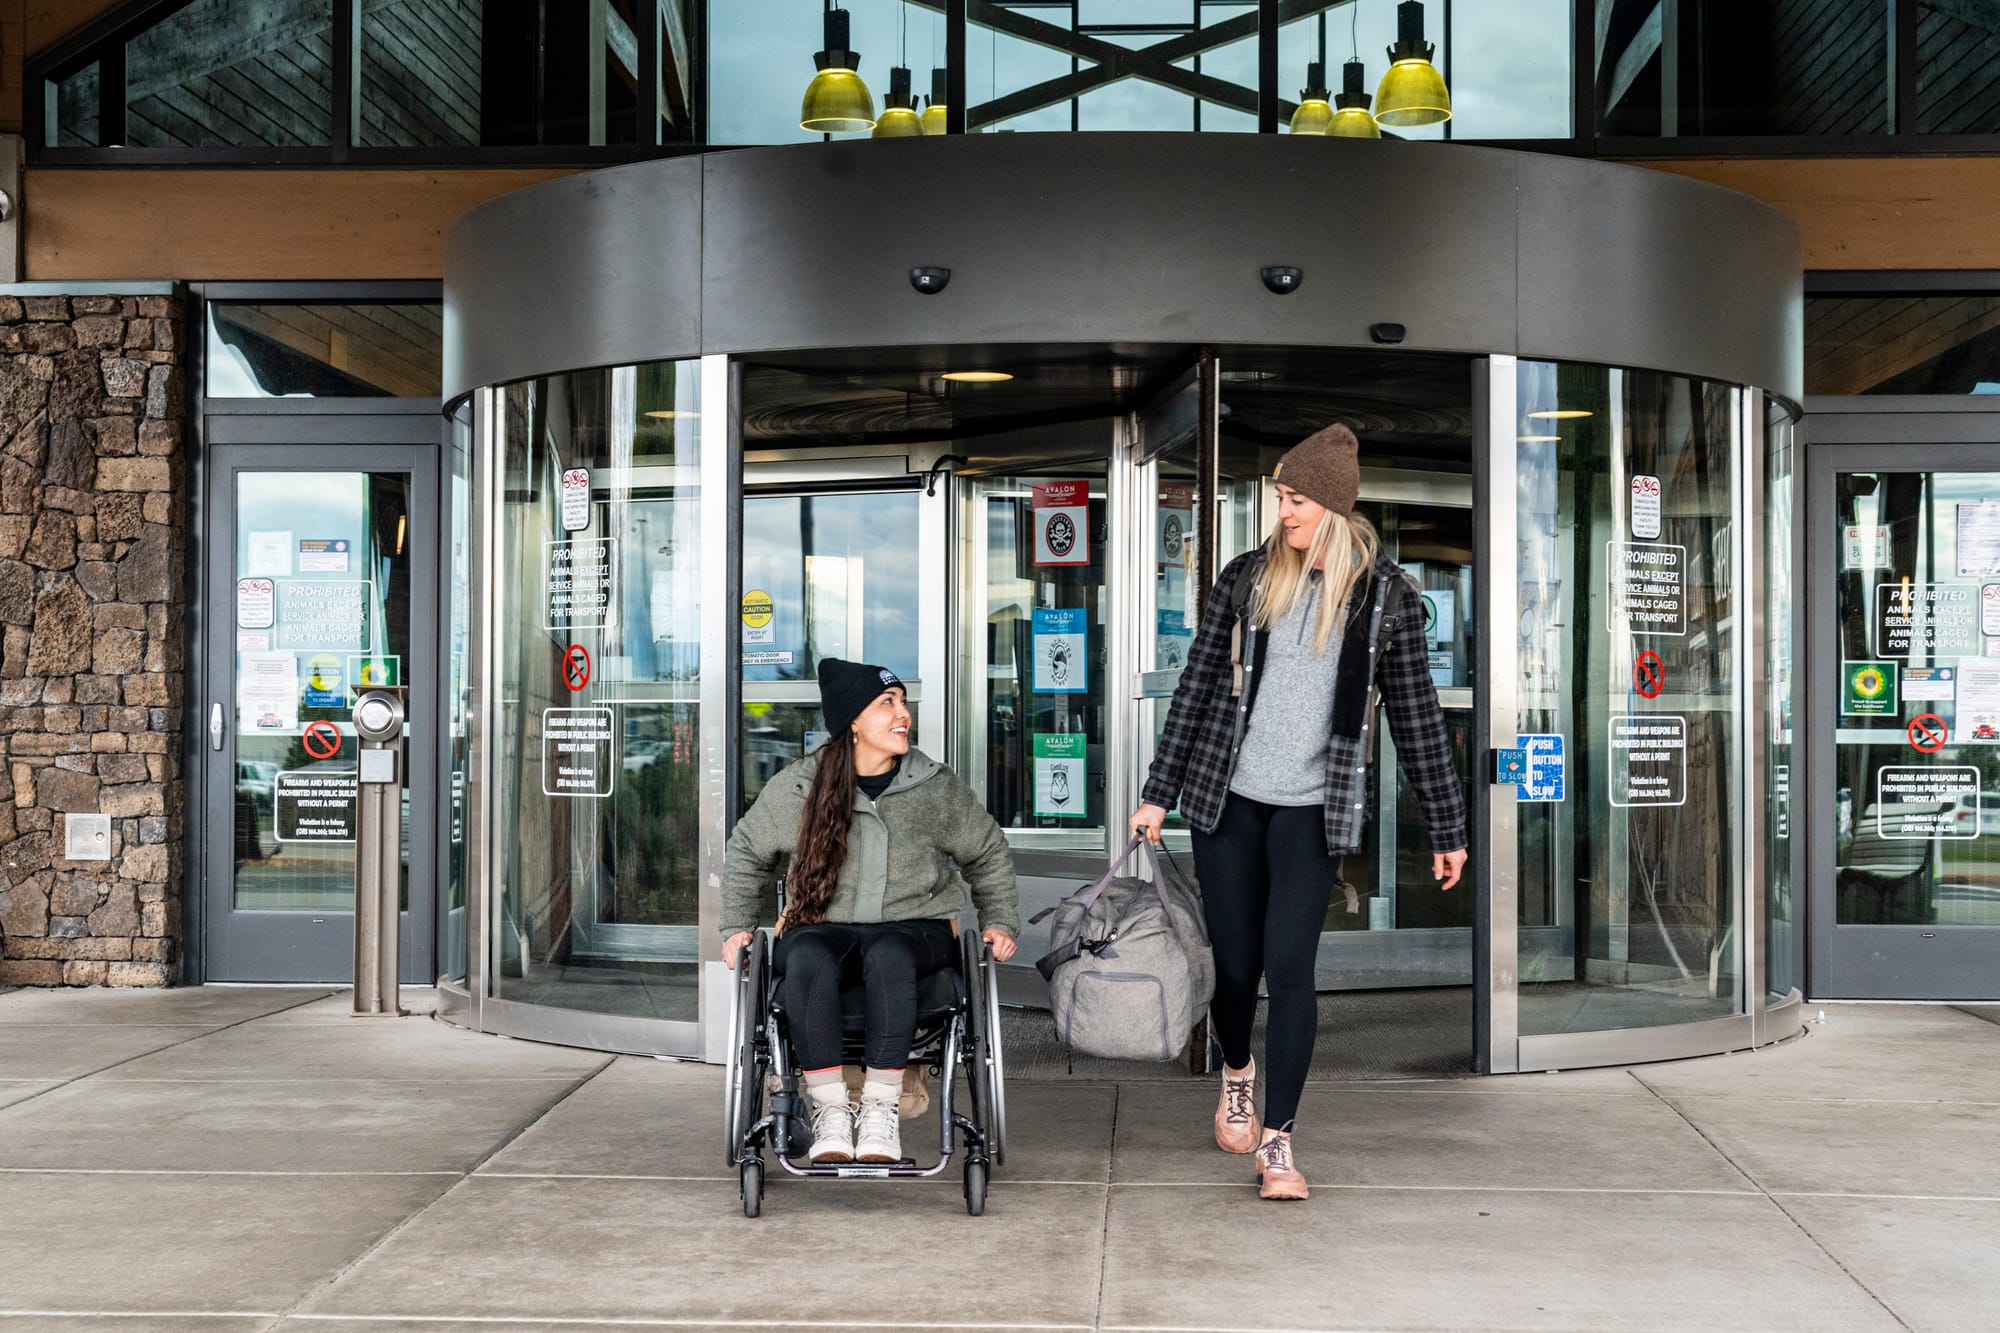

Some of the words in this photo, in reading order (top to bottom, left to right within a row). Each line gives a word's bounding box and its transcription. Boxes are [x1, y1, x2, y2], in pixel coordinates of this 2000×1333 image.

[552, 546, 606, 561] PROHIBITED
[1620, 550, 1676, 566] PROHIBITED
[550, 566, 580, 576] ANIMALS
[580, 564, 608, 575] EXCEPT
[1618, 569, 1650, 580] NIMALS
[1652, 571, 1679, 582] EXCEPT
[549, 580, 572, 590] SERVICE
[600, 578, 610, 588] OR
[288, 586, 362, 597] PROHIBITED
[1643, 584, 1670, 594] ANIMALS
[1671, 586, 1680, 595] OR
[552, 594, 580, 604] ANIMALS
[581, 594, 606, 604] CAGED
[1891, 591, 1967, 600] PROHIBITED
[285, 601, 325, 609] ANIMALS
[1620, 598, 1652, 609] NIMALS
[1653, 600, 1678, 610] CAGED
[550, 608, 564, 618] FOR
[565, 606, 607, 617] TRANSPORT
[1886, 606, 1930, 614] ANIMALS
[1634, 612, 1678, 623] TRANSPORT
[1885, 616, 1920, 625] SERVICE
[288, 624, 327, 632] ANIMALS
[329, 624, 364, 632] CAGED
[1890, 630, 1932, 638] ANIMALS
[1533, 740, 1554, 750] PUSH
[1533, 755, 1562, 765] BUTTON
[1533, 770, 1542, 780] TO
[1533, 786, 1554, 796] SLOW
